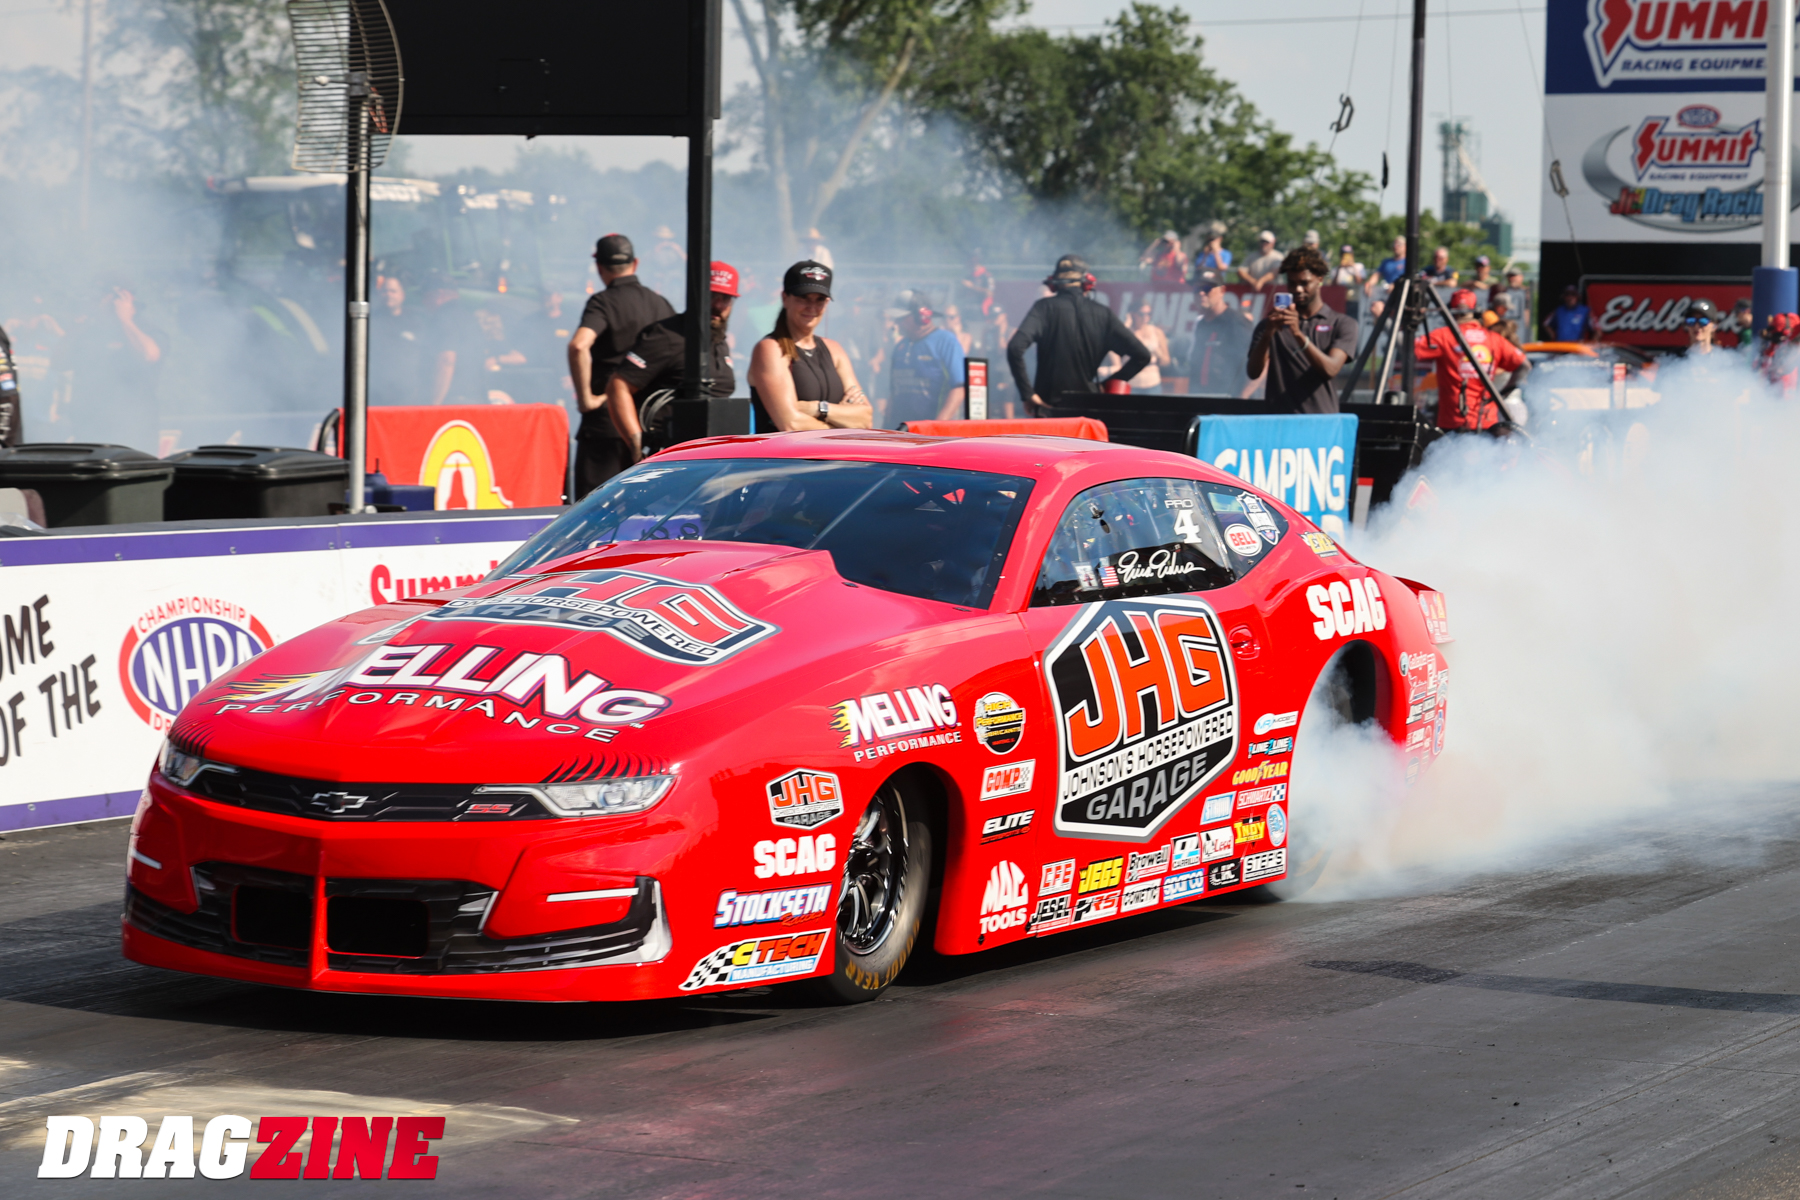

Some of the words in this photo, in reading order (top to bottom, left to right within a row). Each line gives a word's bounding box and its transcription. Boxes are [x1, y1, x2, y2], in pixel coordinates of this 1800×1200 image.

[1600, 0, 1769, 57] SUMMI
[1620, 58, 1684, 72] RACING
[1164, 499, 1195, 509] PRO
[1174, 509, 1202, 544] 4
[1229, 532, 1257, 547] BELL
[137, 596, 247, 634] CHAMPIONSHIP
[1305, 577, 1387, 640] SCAG
[0, 594, 55, 684] ME
[38, 654, 102, 738] THE
[228, 643, 672, 724] MELLING
[1065, 610, 1229, 762] JHG
[215, 688, 621, 743] PERFORMANCE
[847, 682, 958, 748] MELLING
[975, 711, 1023, 727] PERFORMANCE
[984, 700, 1012, 712] HIGH
[853, 731, 963, 763] PERFORMANCE
[1063, 750, 1135, 800] JOHNSON'S
[1138, 710, 1233, 764] HORSEPOWERED
[771, 774, 839, 809] JHG
[985, 767, 1021, 793] COMP
[1085, 752, 1208, 821] GARAGE
[464, 803, 513, 814] SS
[784, 810, 832, 825] GARAGE
[982, 809, 1035, 835] ELITE
[1234, 821, 1266, 845] INDY
[753, 833, 836, 879] SCAG
[1129, 845, 1168, 871] Browell
[1173, 856, 1199, 869] CARRILLO
[1246, 851, 1283, 872] STEF'S
[980, 860, 1028, 915] MAC
[1079, 857, 1124, 893] JEGS
[1163, 871, 1204, 897] sparco
[714, 883, 832, 928] STOCKSETH
[979, 907, 1027, 934] TOOLS
[731, 958, 815, 981] MANUFACTURING
